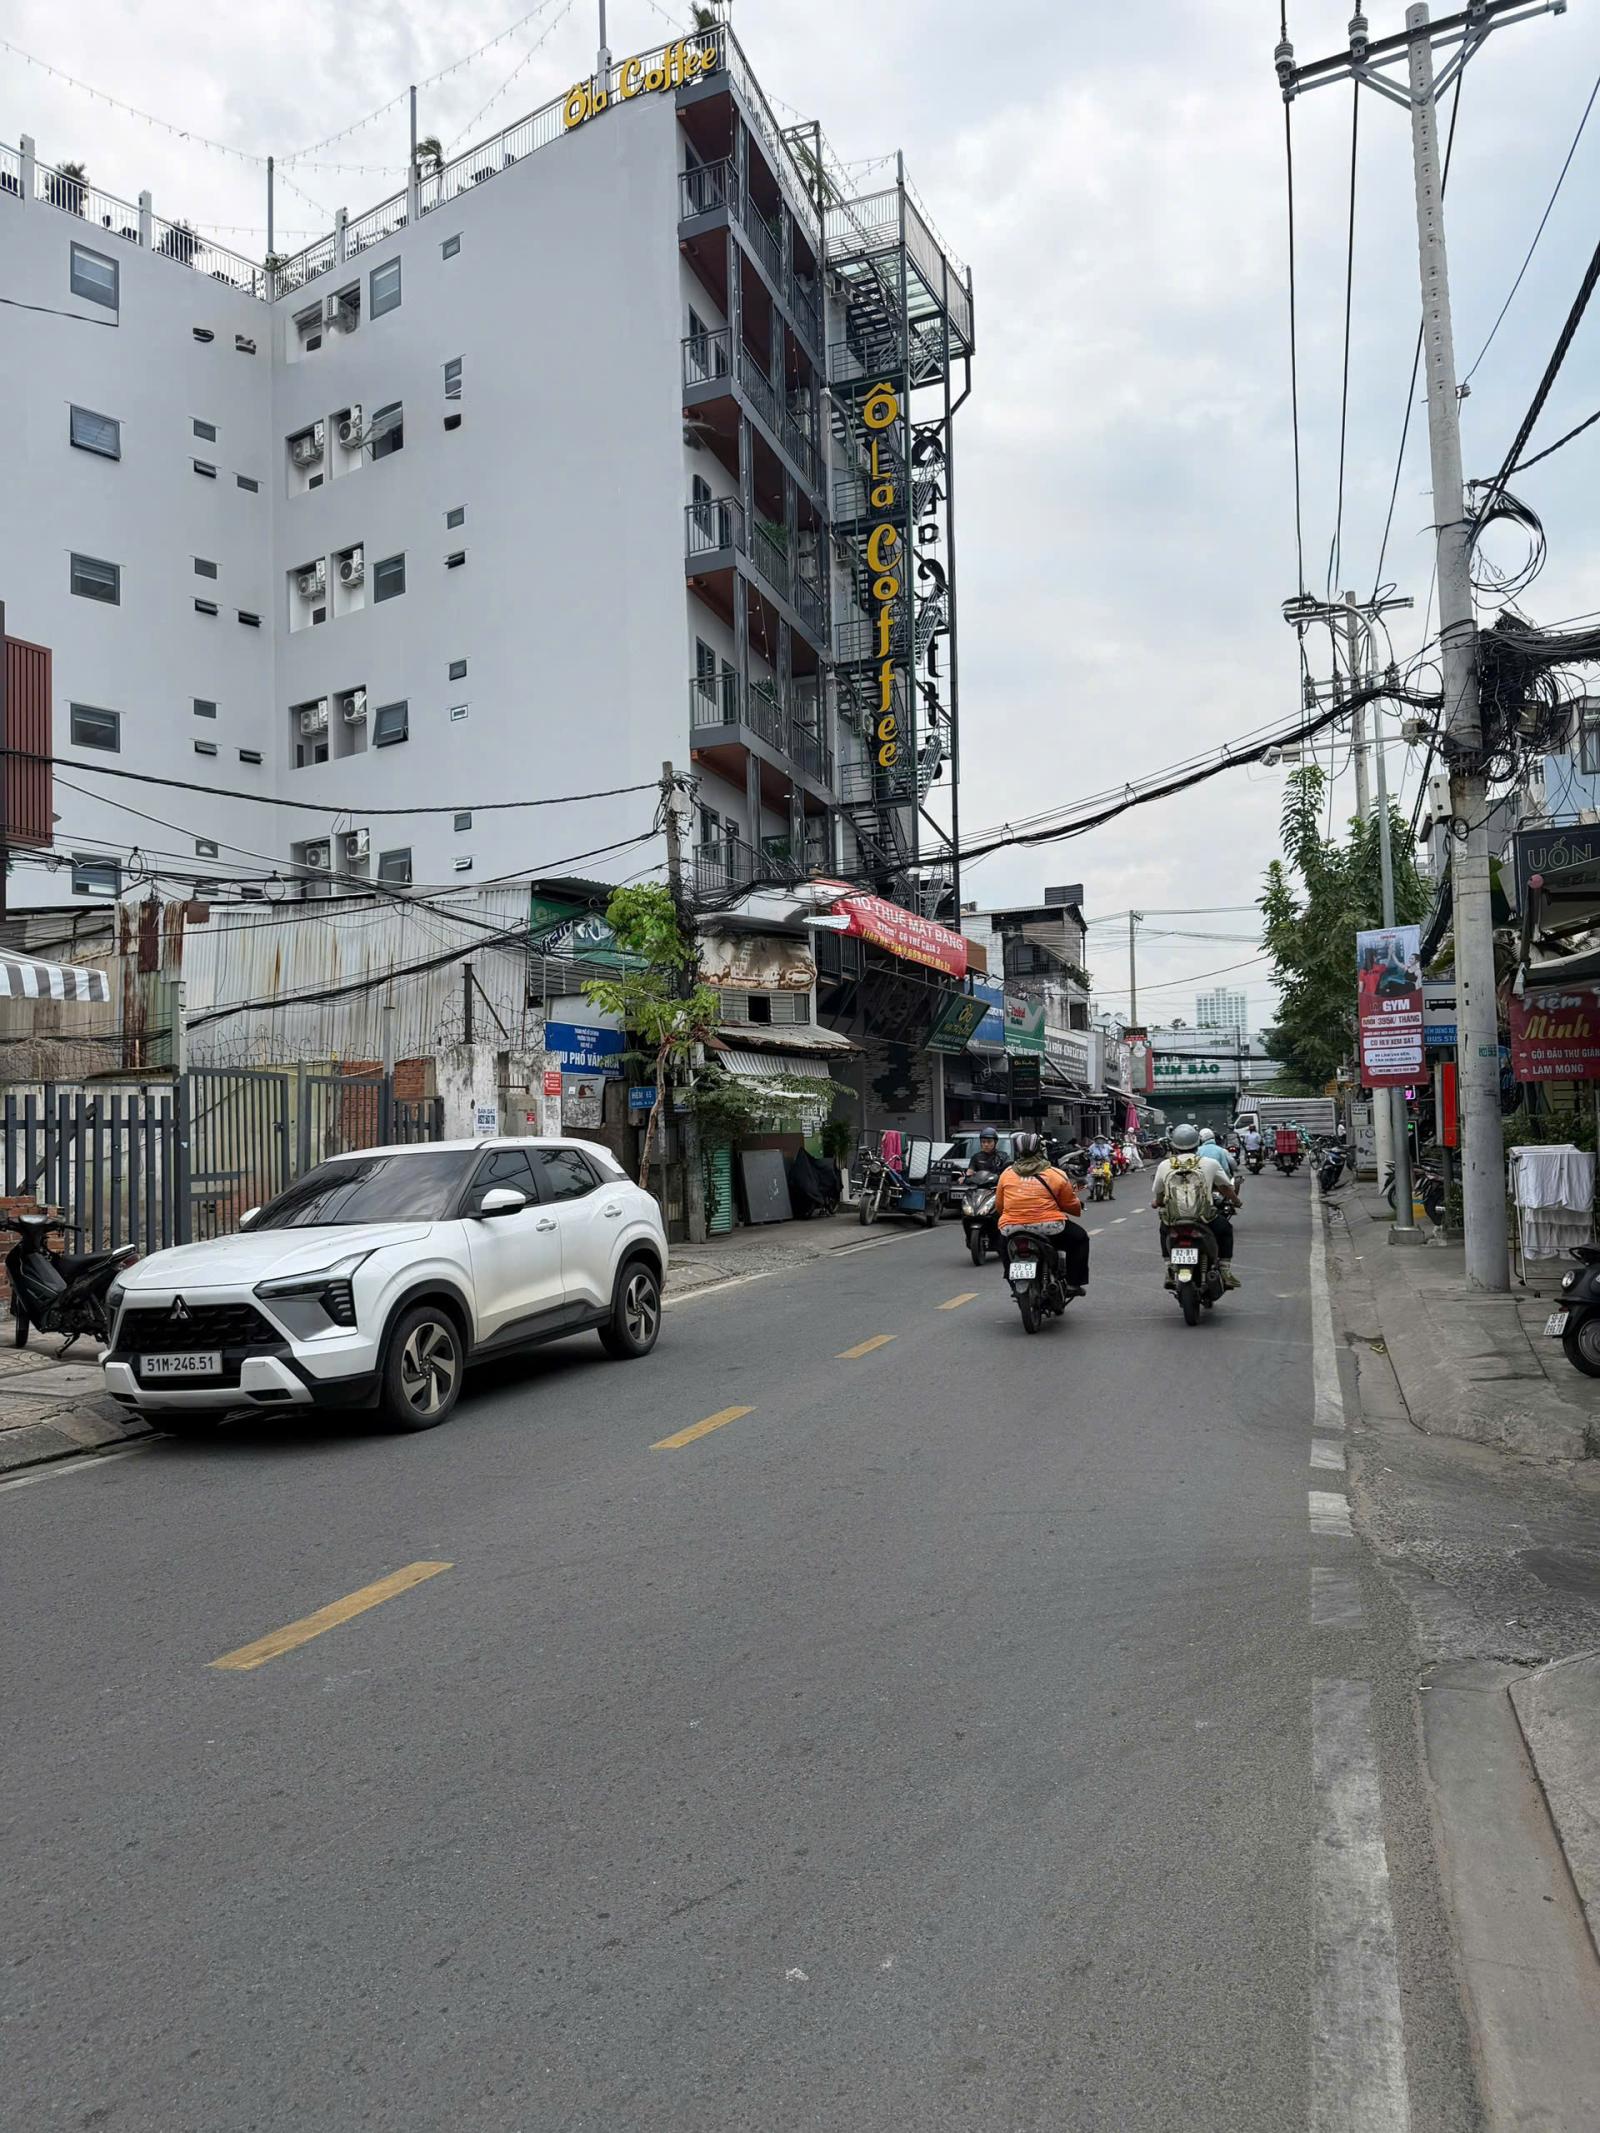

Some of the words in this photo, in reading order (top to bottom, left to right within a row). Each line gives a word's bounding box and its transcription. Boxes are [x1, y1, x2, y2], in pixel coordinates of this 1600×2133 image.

[563, 80, 608, 130] Ôla
[619, 38, 717, 101] Coffee
[867, 523, 903, 768] Coffee
[1528, 836, 1592, 872] UỐN
[1382, 998, 1411, 1013] GYM
[1518, 1013, 1593, 1041] Minh
[569, 1048, 586, 1066] PHỐ
[1153, 1064, 1182, 1076] KIM
[1187, 1060, 1220, 1075] BẢO
[147, 1356, 214, 1372] 51M-246.51
